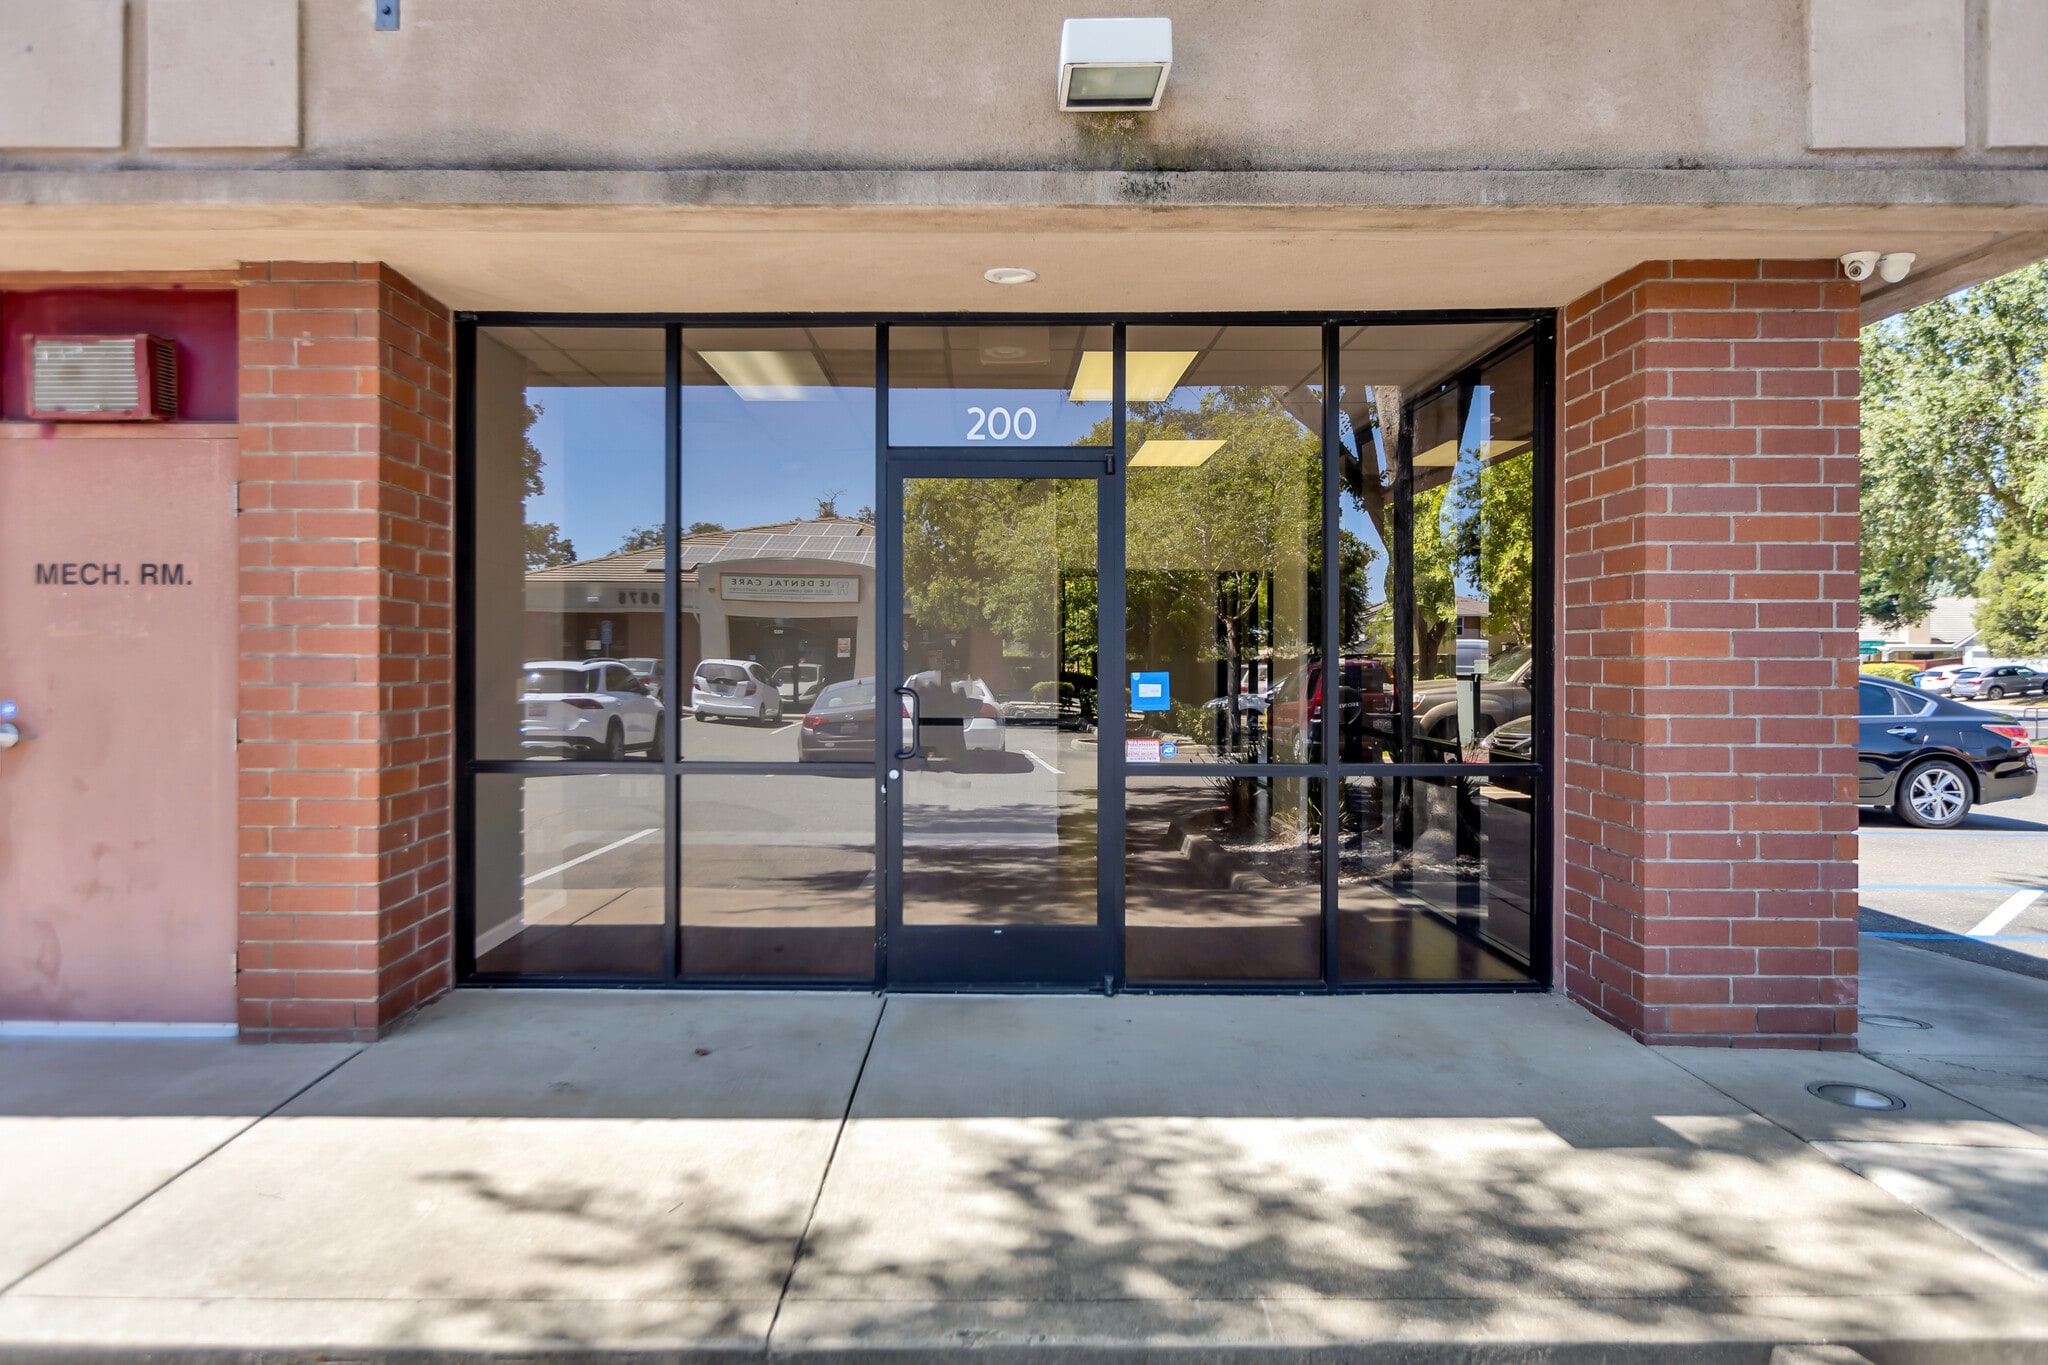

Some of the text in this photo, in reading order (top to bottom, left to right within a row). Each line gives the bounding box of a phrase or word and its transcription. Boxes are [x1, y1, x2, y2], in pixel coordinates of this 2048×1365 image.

[966, 406, 1037, 441] 200
[34, 562, 194, 585] MECH. RM.
